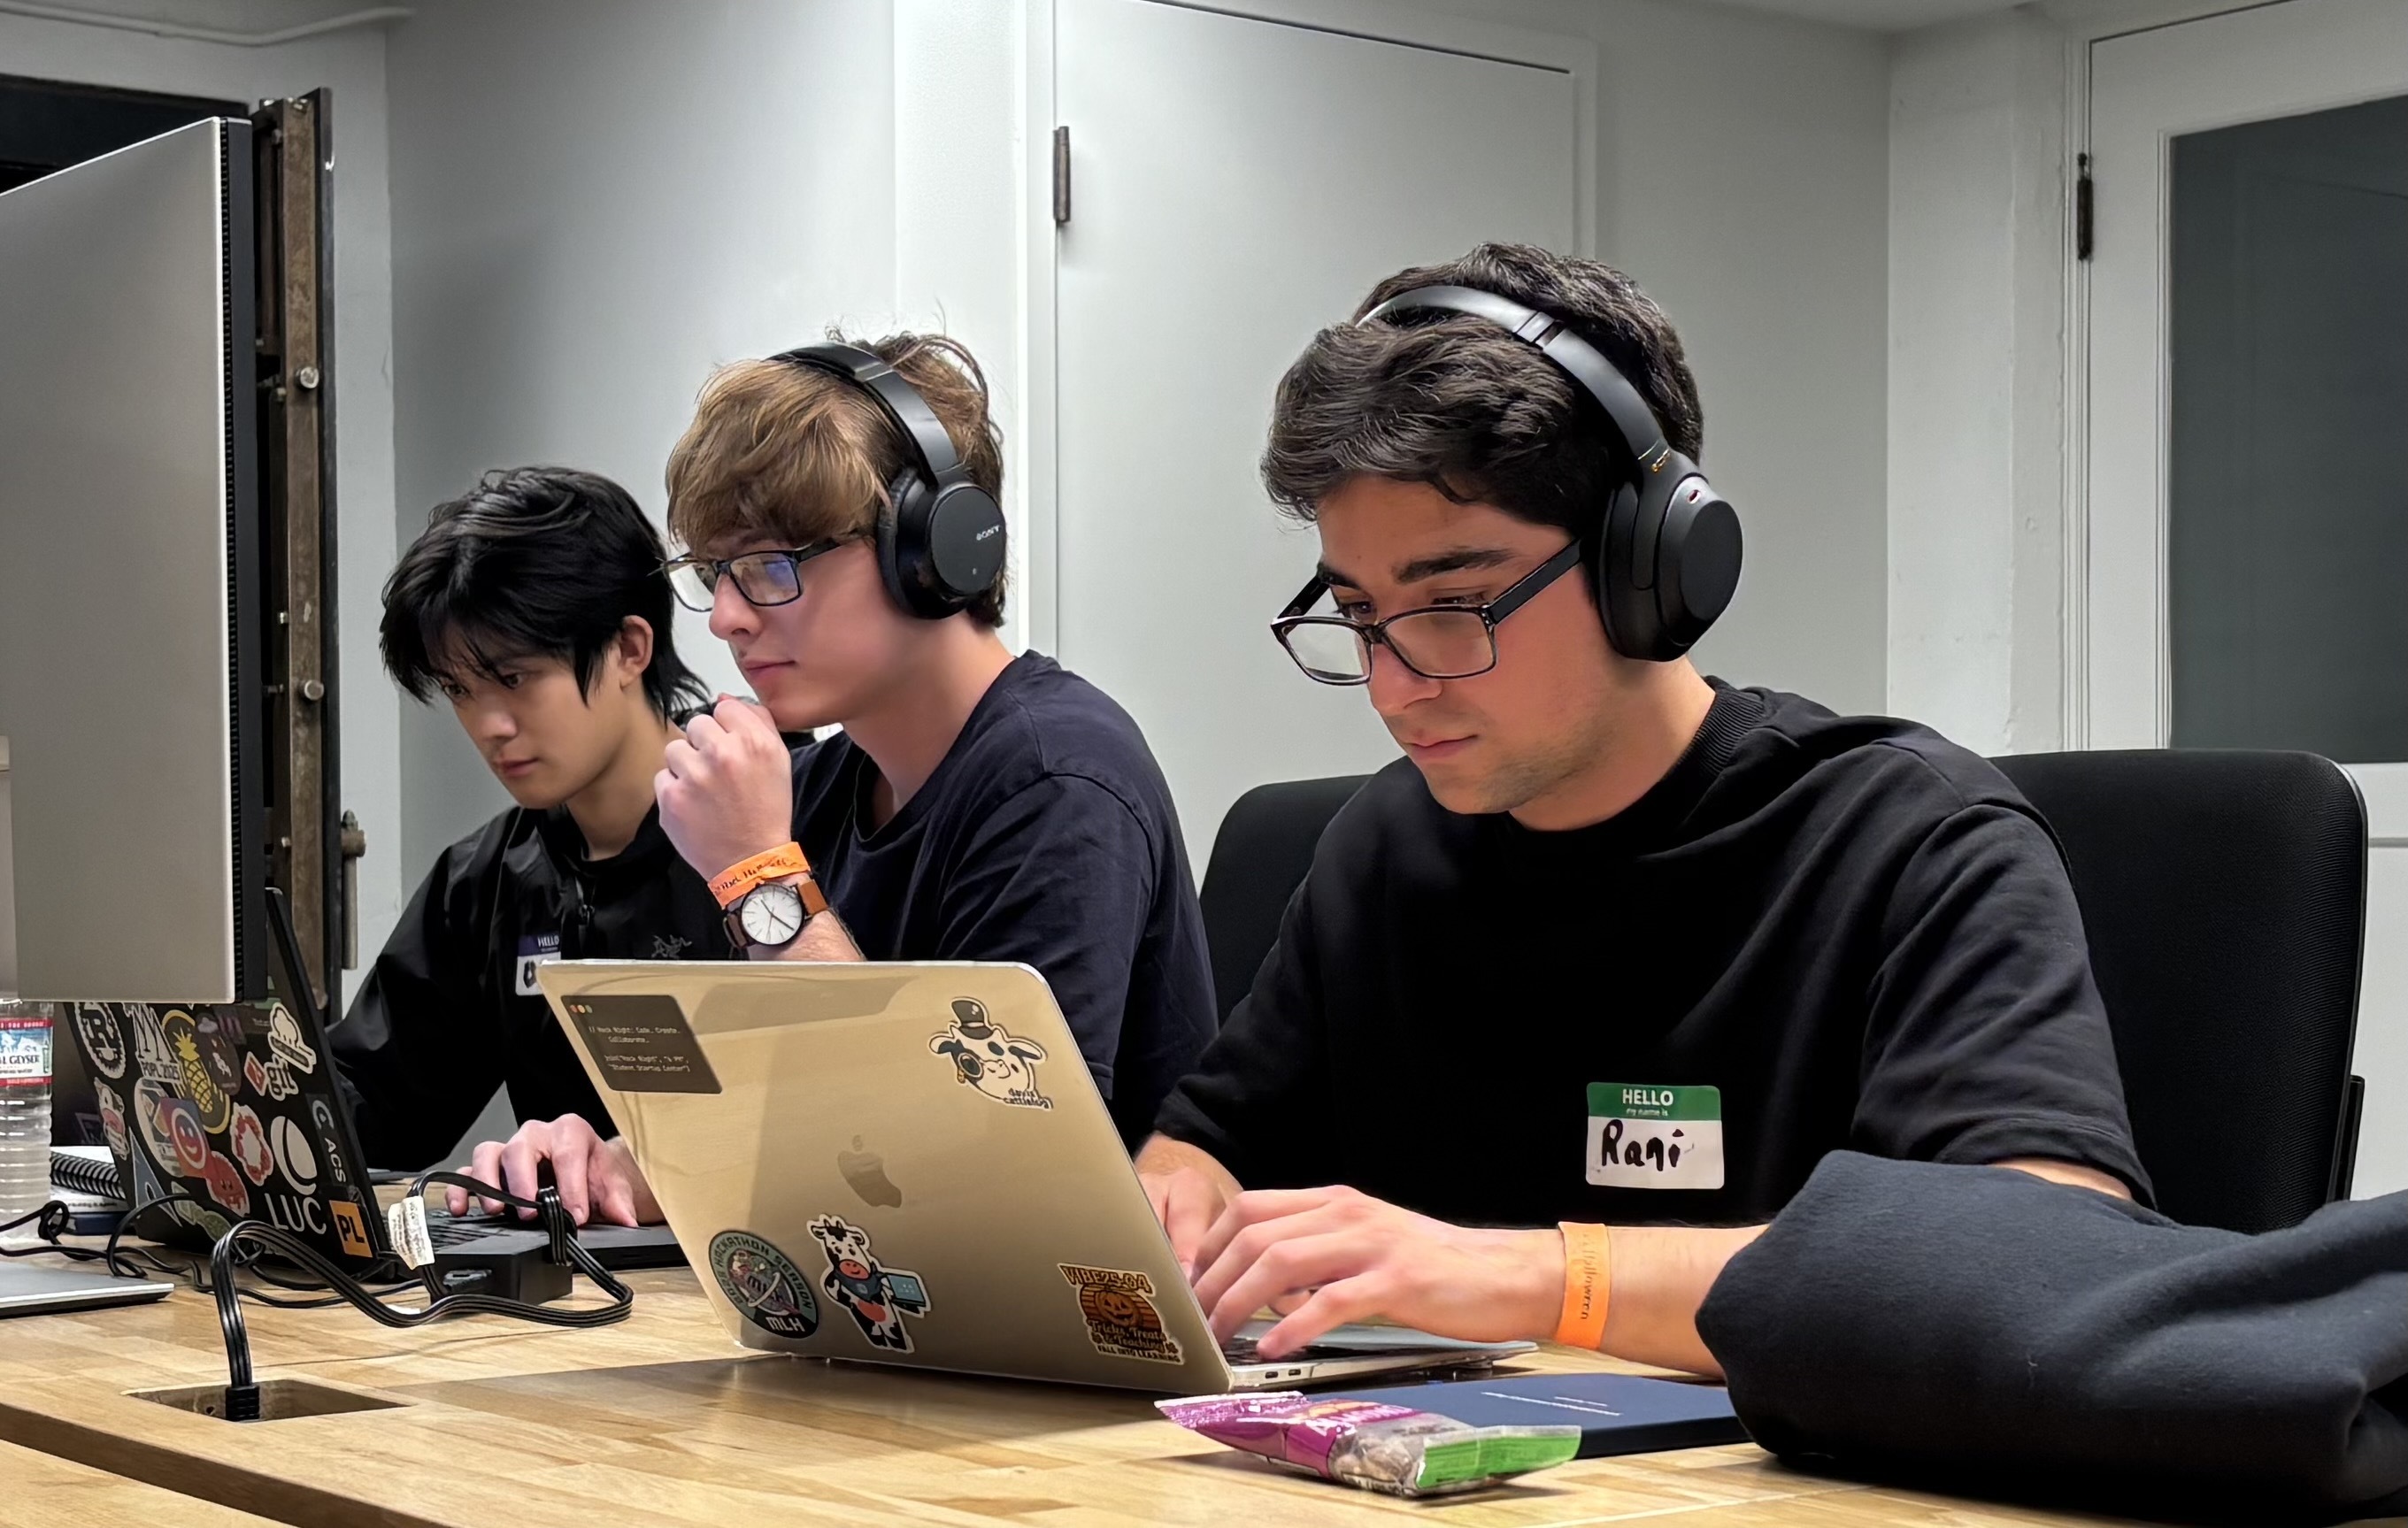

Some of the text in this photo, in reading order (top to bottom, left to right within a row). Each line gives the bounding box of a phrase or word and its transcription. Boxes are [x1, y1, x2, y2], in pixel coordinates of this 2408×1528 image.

[976, 525, 1000, 541] SONY
[266, 1056, 295, 1096] git
[1622, 1088, 1673, 1106] HELLO
[264, 1193, 327, 1235] LUC
[336, 1214, 365, 1243] PL
[714, 1236, 770, 1268] HACKATHON
[774, 1255, 812, 1309] SEASON
[765, 1316, 805, 1332] MLH
